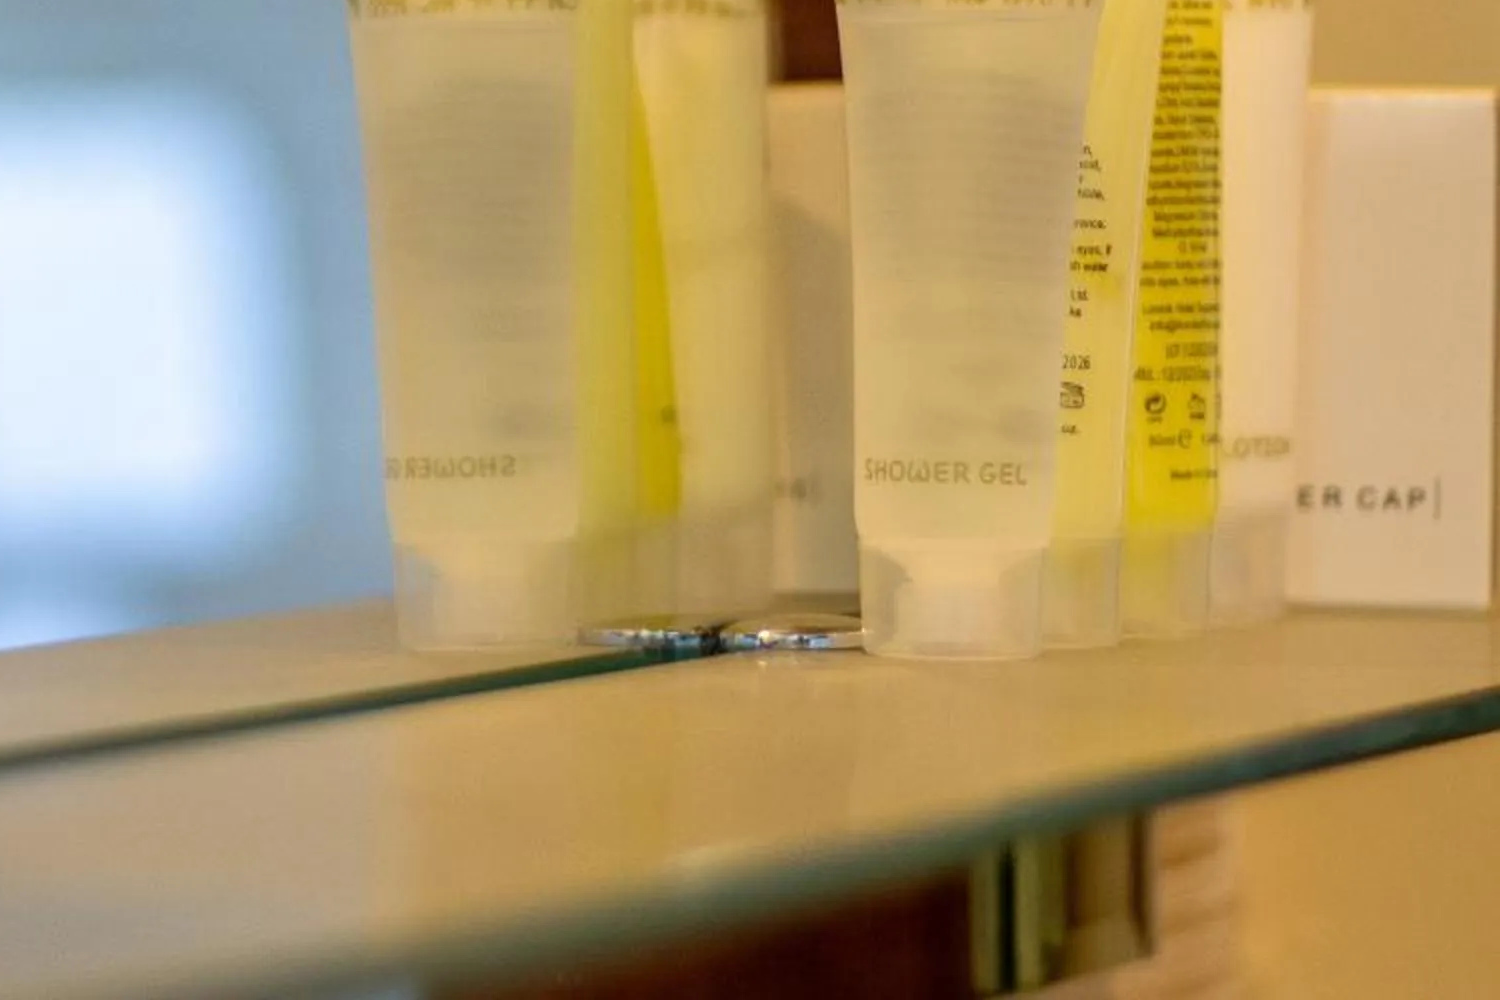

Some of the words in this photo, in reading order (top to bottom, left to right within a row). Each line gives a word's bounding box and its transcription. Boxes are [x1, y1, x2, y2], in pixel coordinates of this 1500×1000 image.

[863, 457, 971, 484] SHOWER
[978, 461, 1028, 486] GEL
[1355, 484, 1427, 512] CAP
